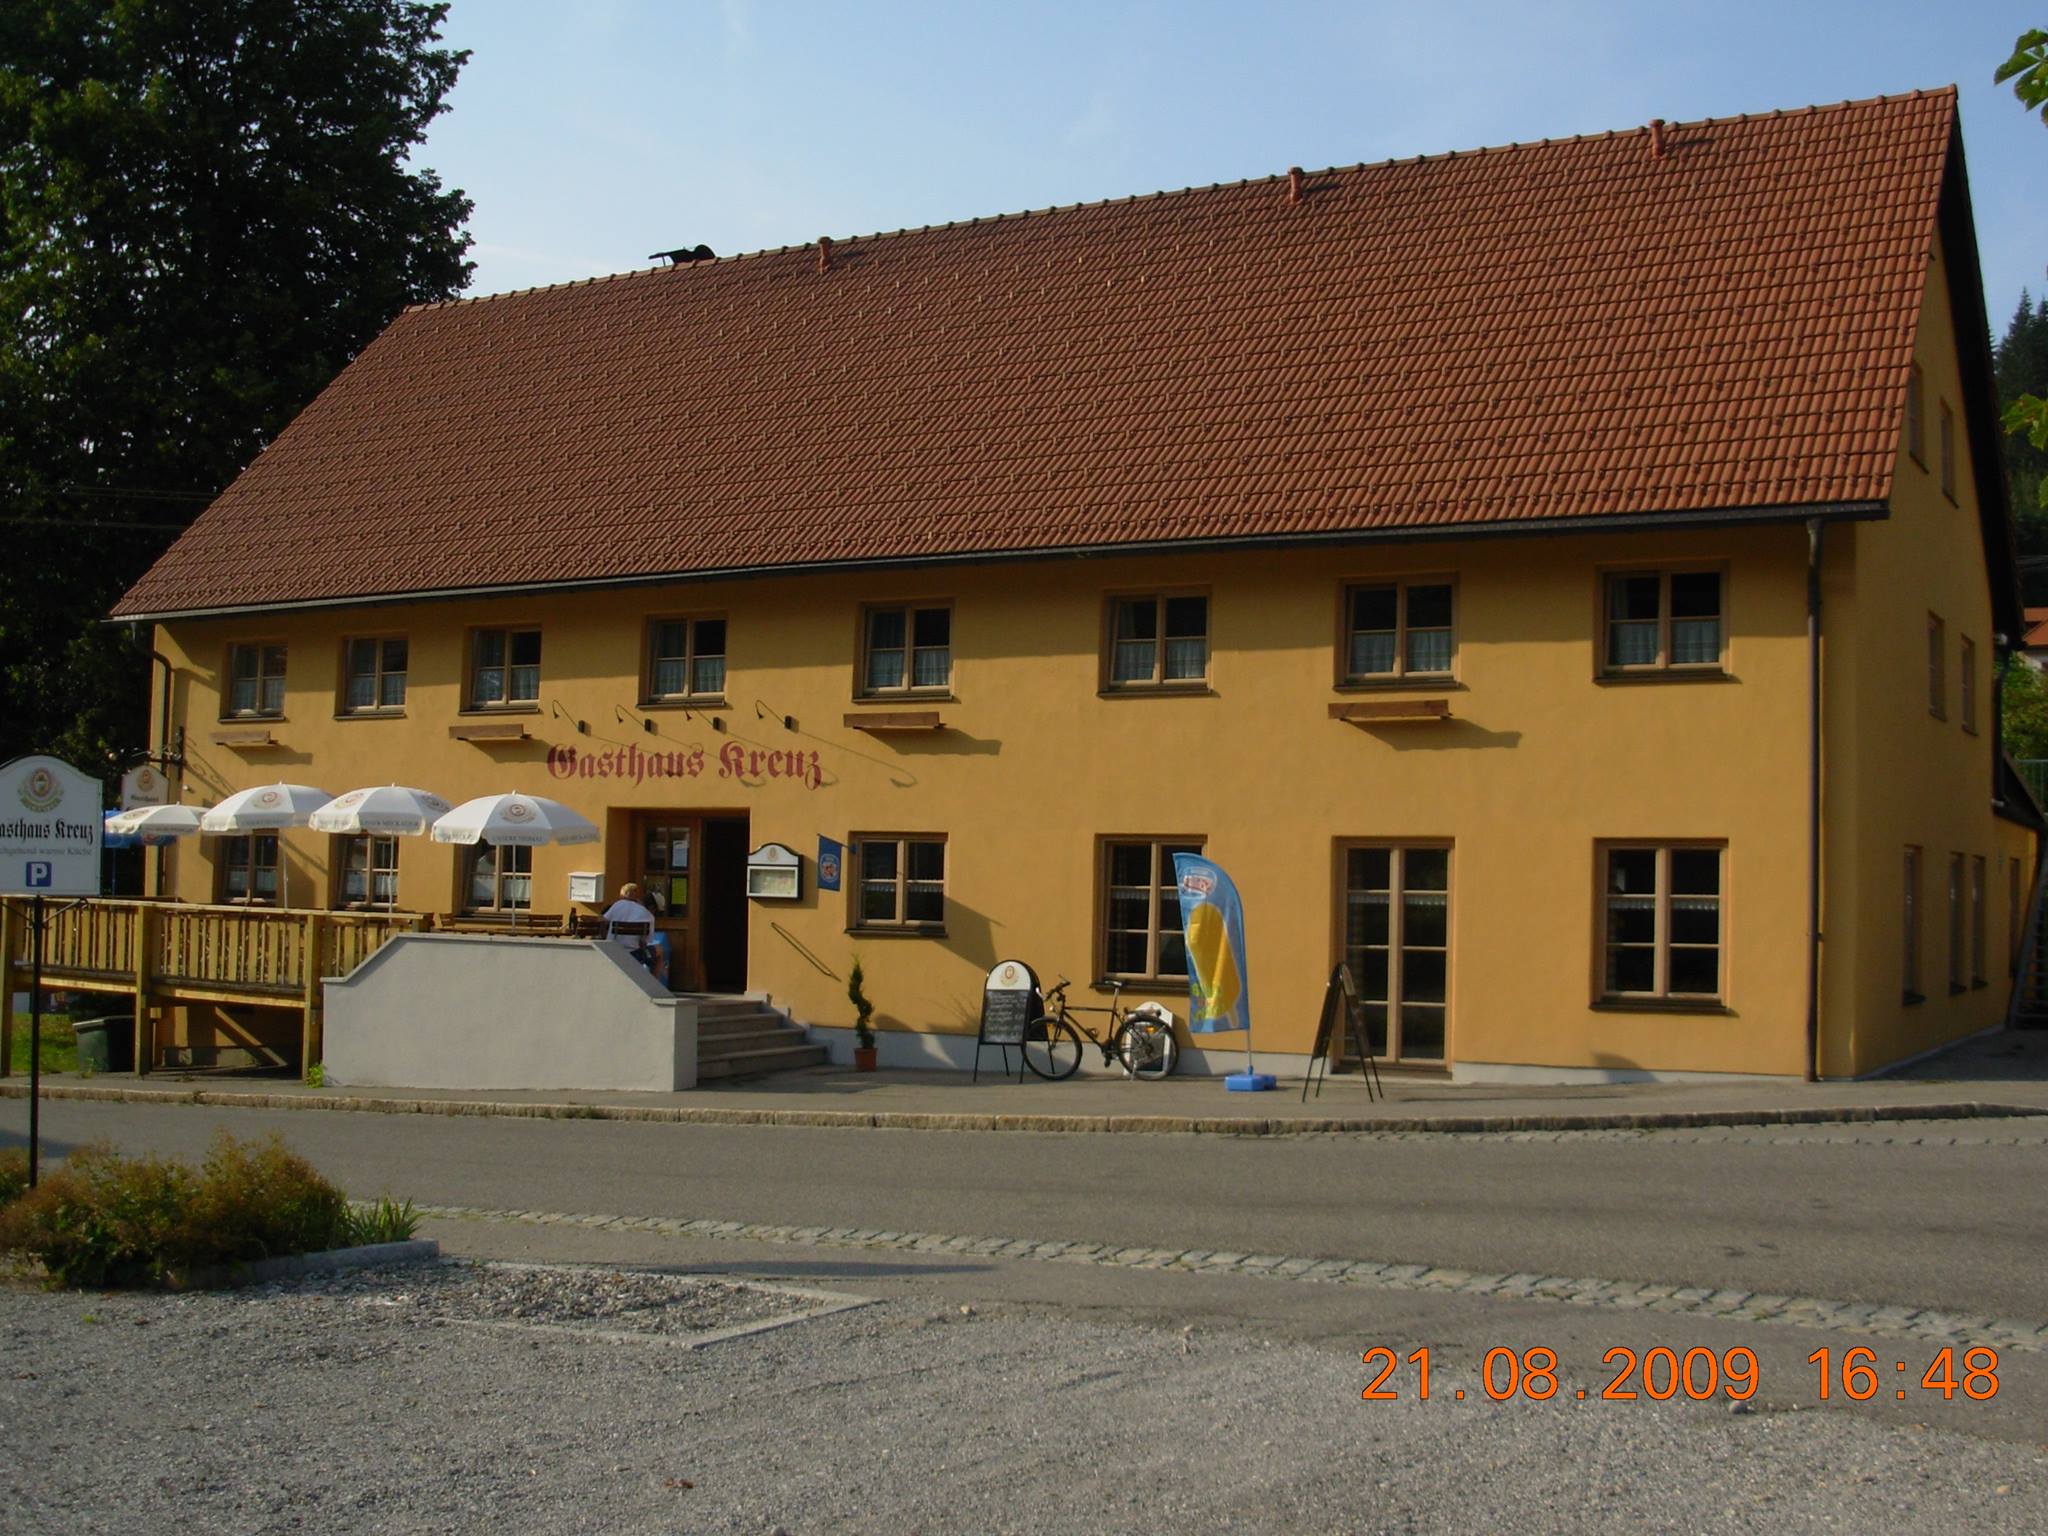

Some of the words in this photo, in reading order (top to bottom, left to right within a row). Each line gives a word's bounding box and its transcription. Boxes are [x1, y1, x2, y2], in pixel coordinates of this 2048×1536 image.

[547, 741, 704, 789] Gasthaus
[718, 741, 822, 791] Kreuz
[0, 817, 50, 843] asthaus
[55, 818, 94, 846] Kreuz
[30, 863, 48, 886] P
